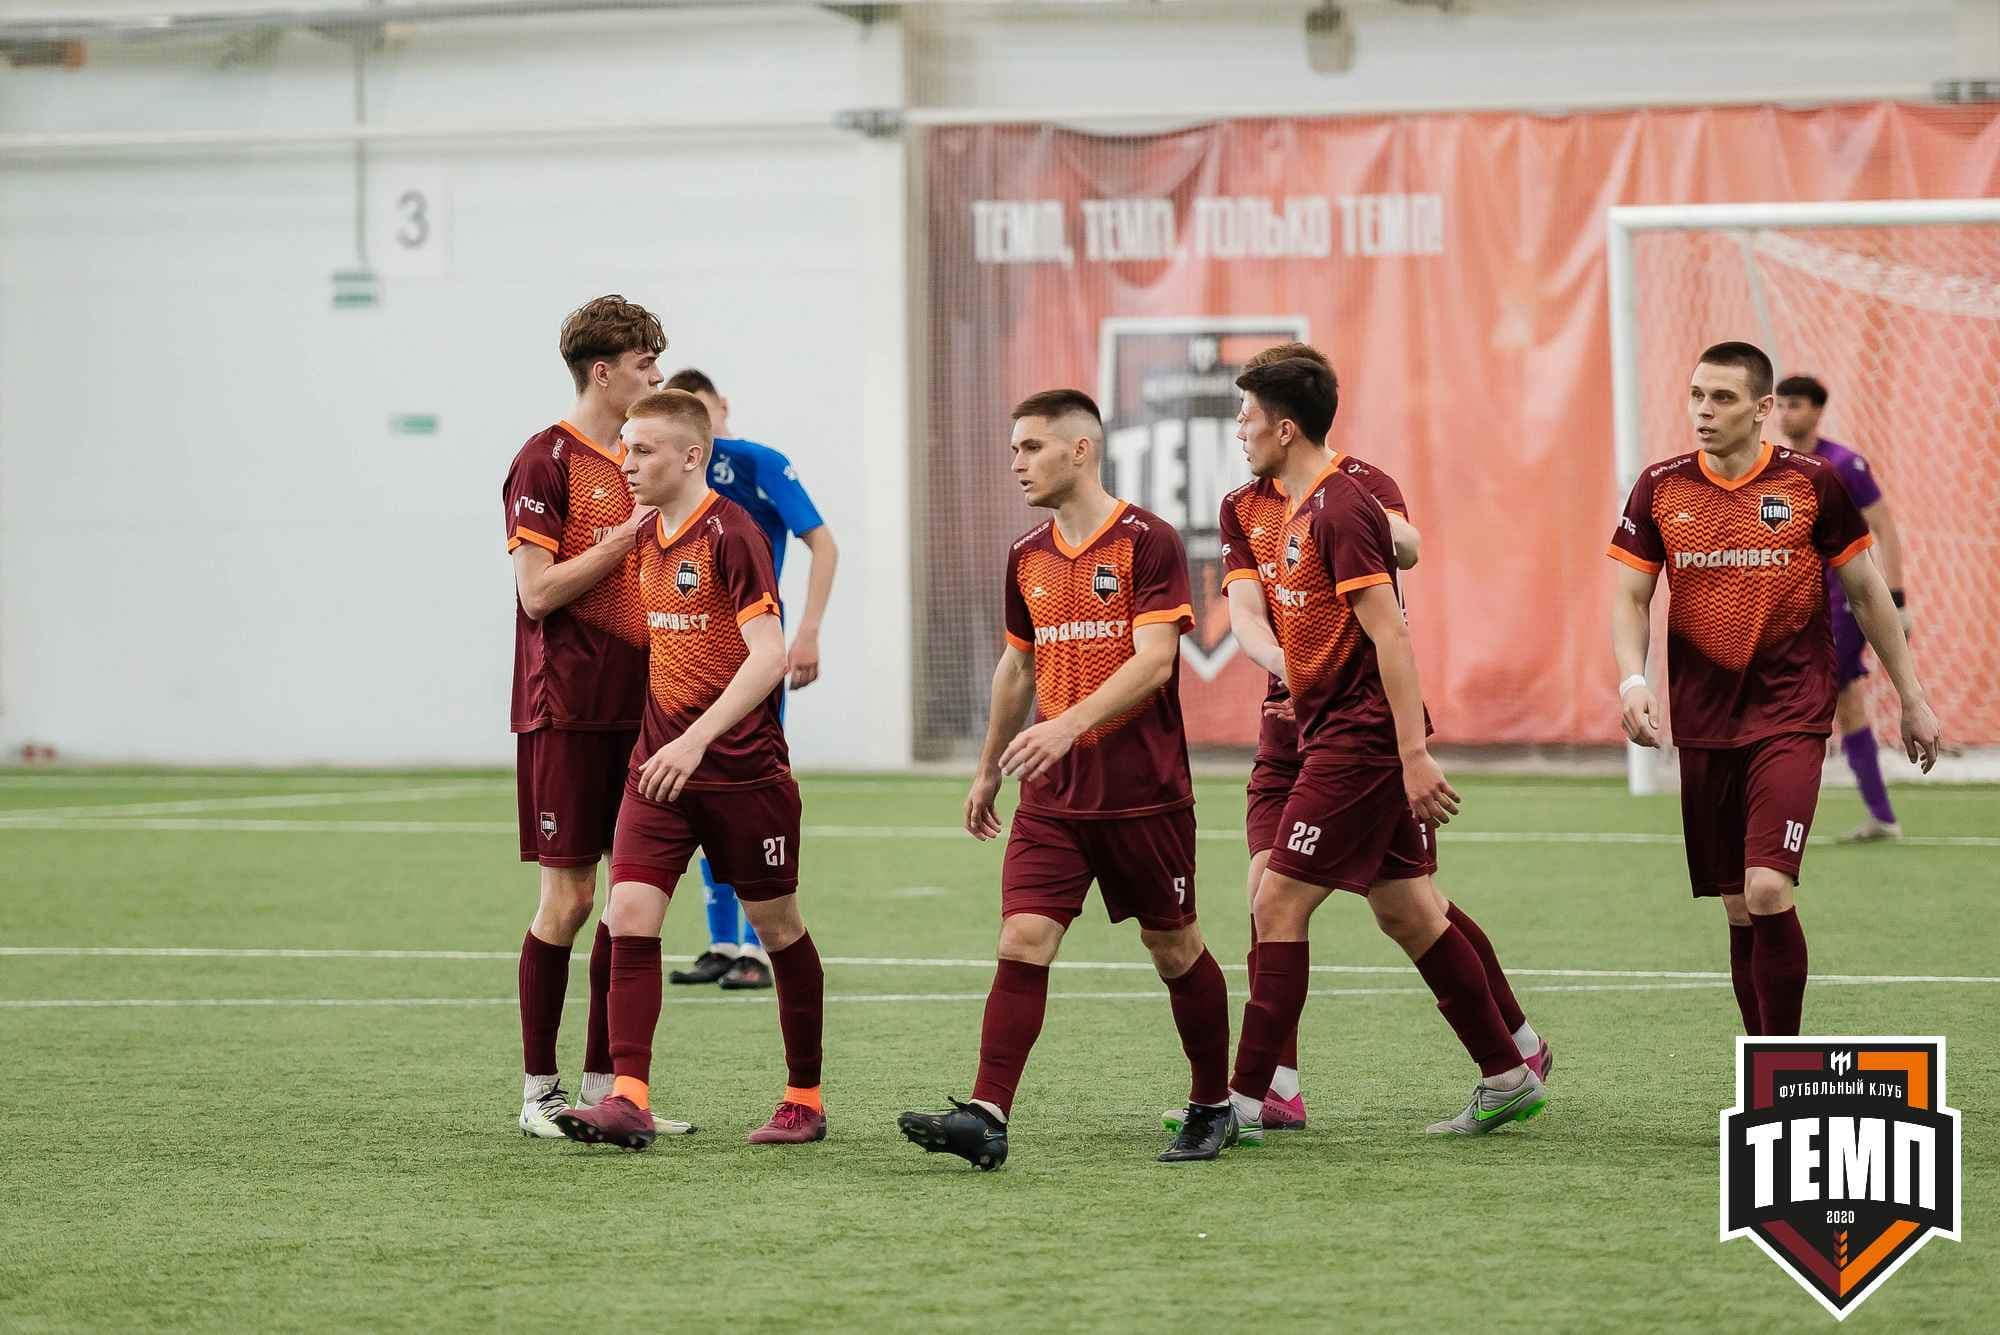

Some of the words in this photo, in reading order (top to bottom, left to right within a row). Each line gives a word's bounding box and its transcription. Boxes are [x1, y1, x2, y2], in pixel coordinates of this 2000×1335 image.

[397, 189, 429, 248] 3
[1107, 417, 1241, 531] ТЕМ
[520, 496, 545, 514] ПСБ
[1762, 505, 1789, 520] ТЕМП
[763, 836, 786, 866] 27
[1287, 821, 1321, 856] 22
[1783, 820, 1804, 853] 19
